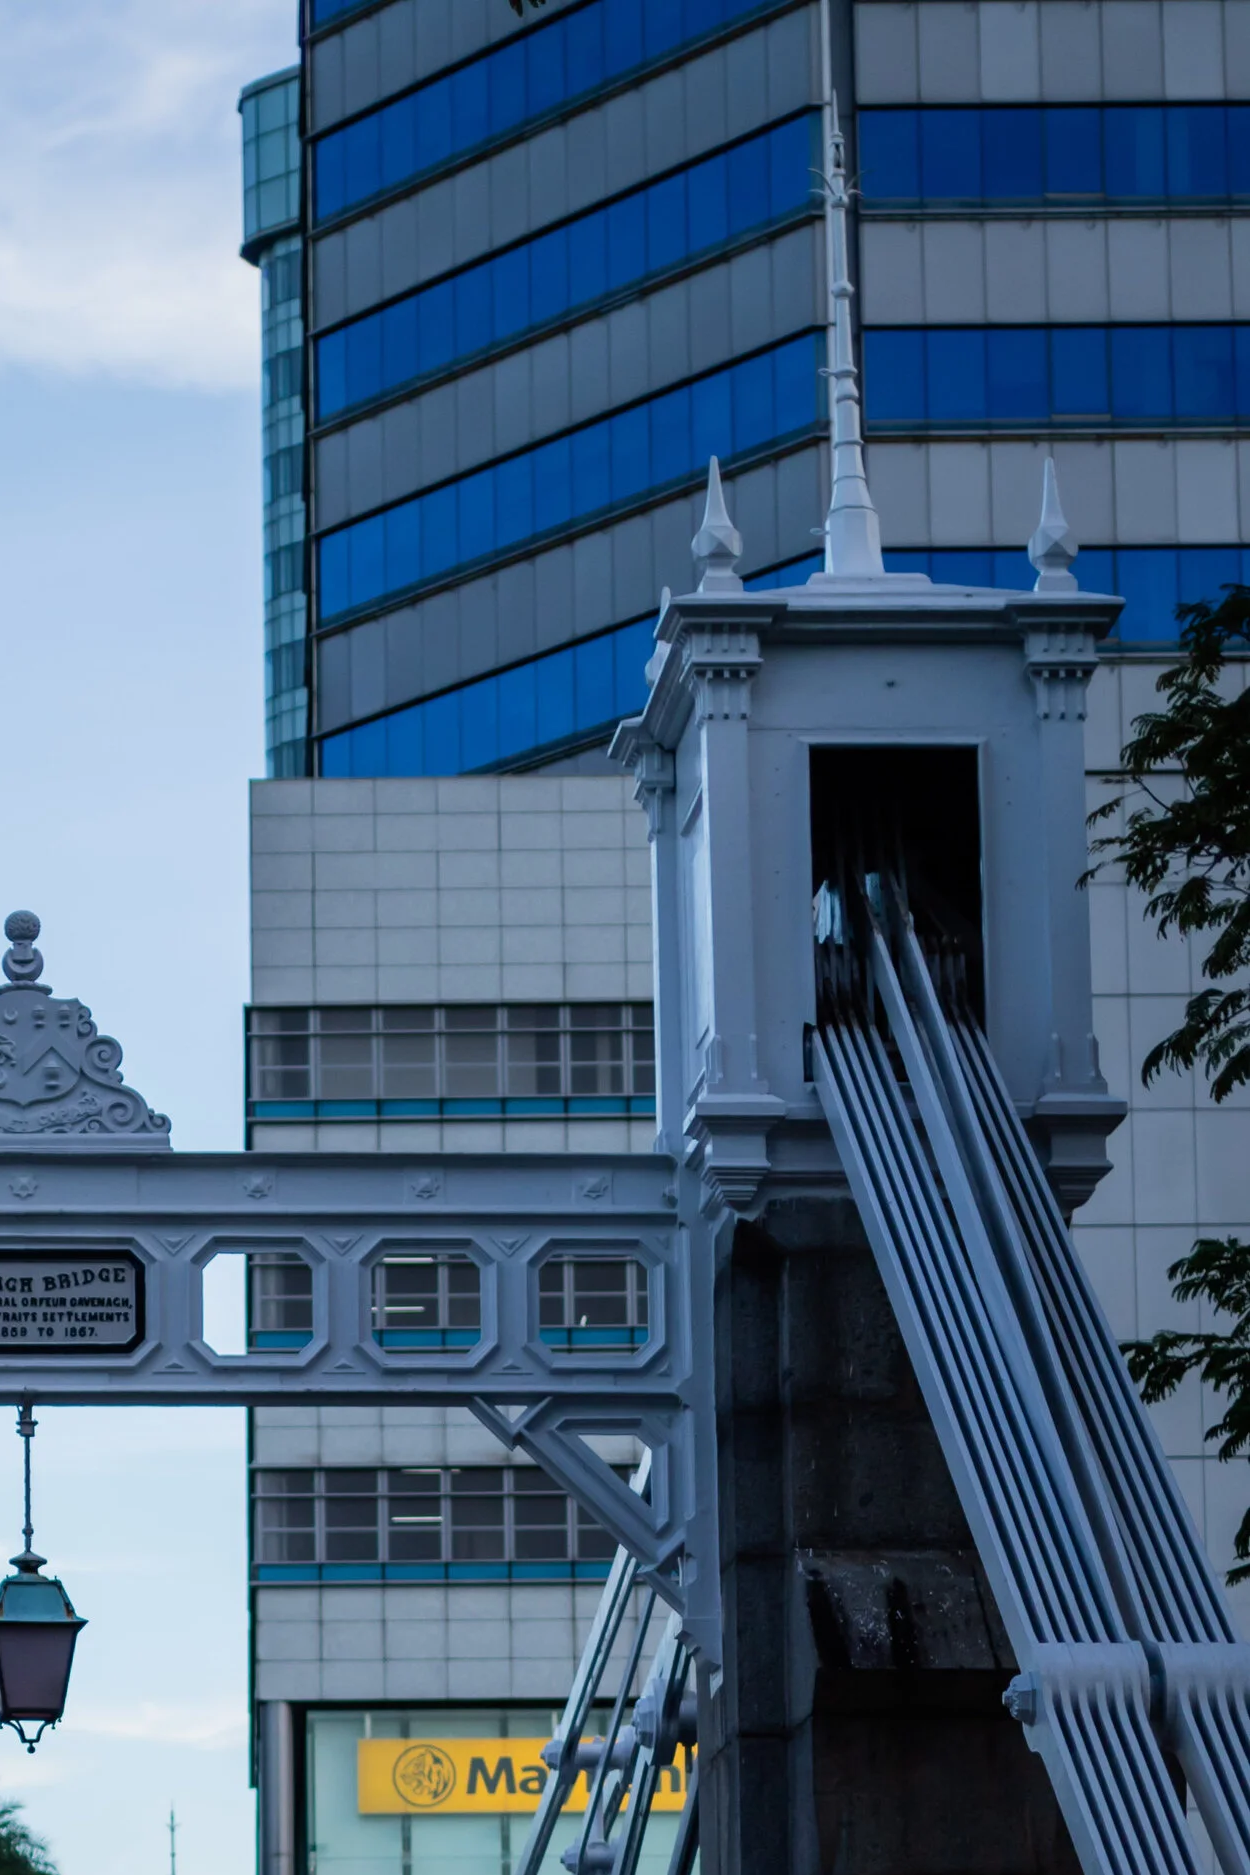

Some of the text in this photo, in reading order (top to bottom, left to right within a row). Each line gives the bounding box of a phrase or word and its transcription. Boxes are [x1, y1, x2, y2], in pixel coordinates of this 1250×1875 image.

[43, 1267, 126, 1292] BRIDGE
[21, 1297, 67, 1307] ORFEUR
[42, 1312, 130, 1322] SETTLEMENTS
[38, 1327, 54, 1337] TO
